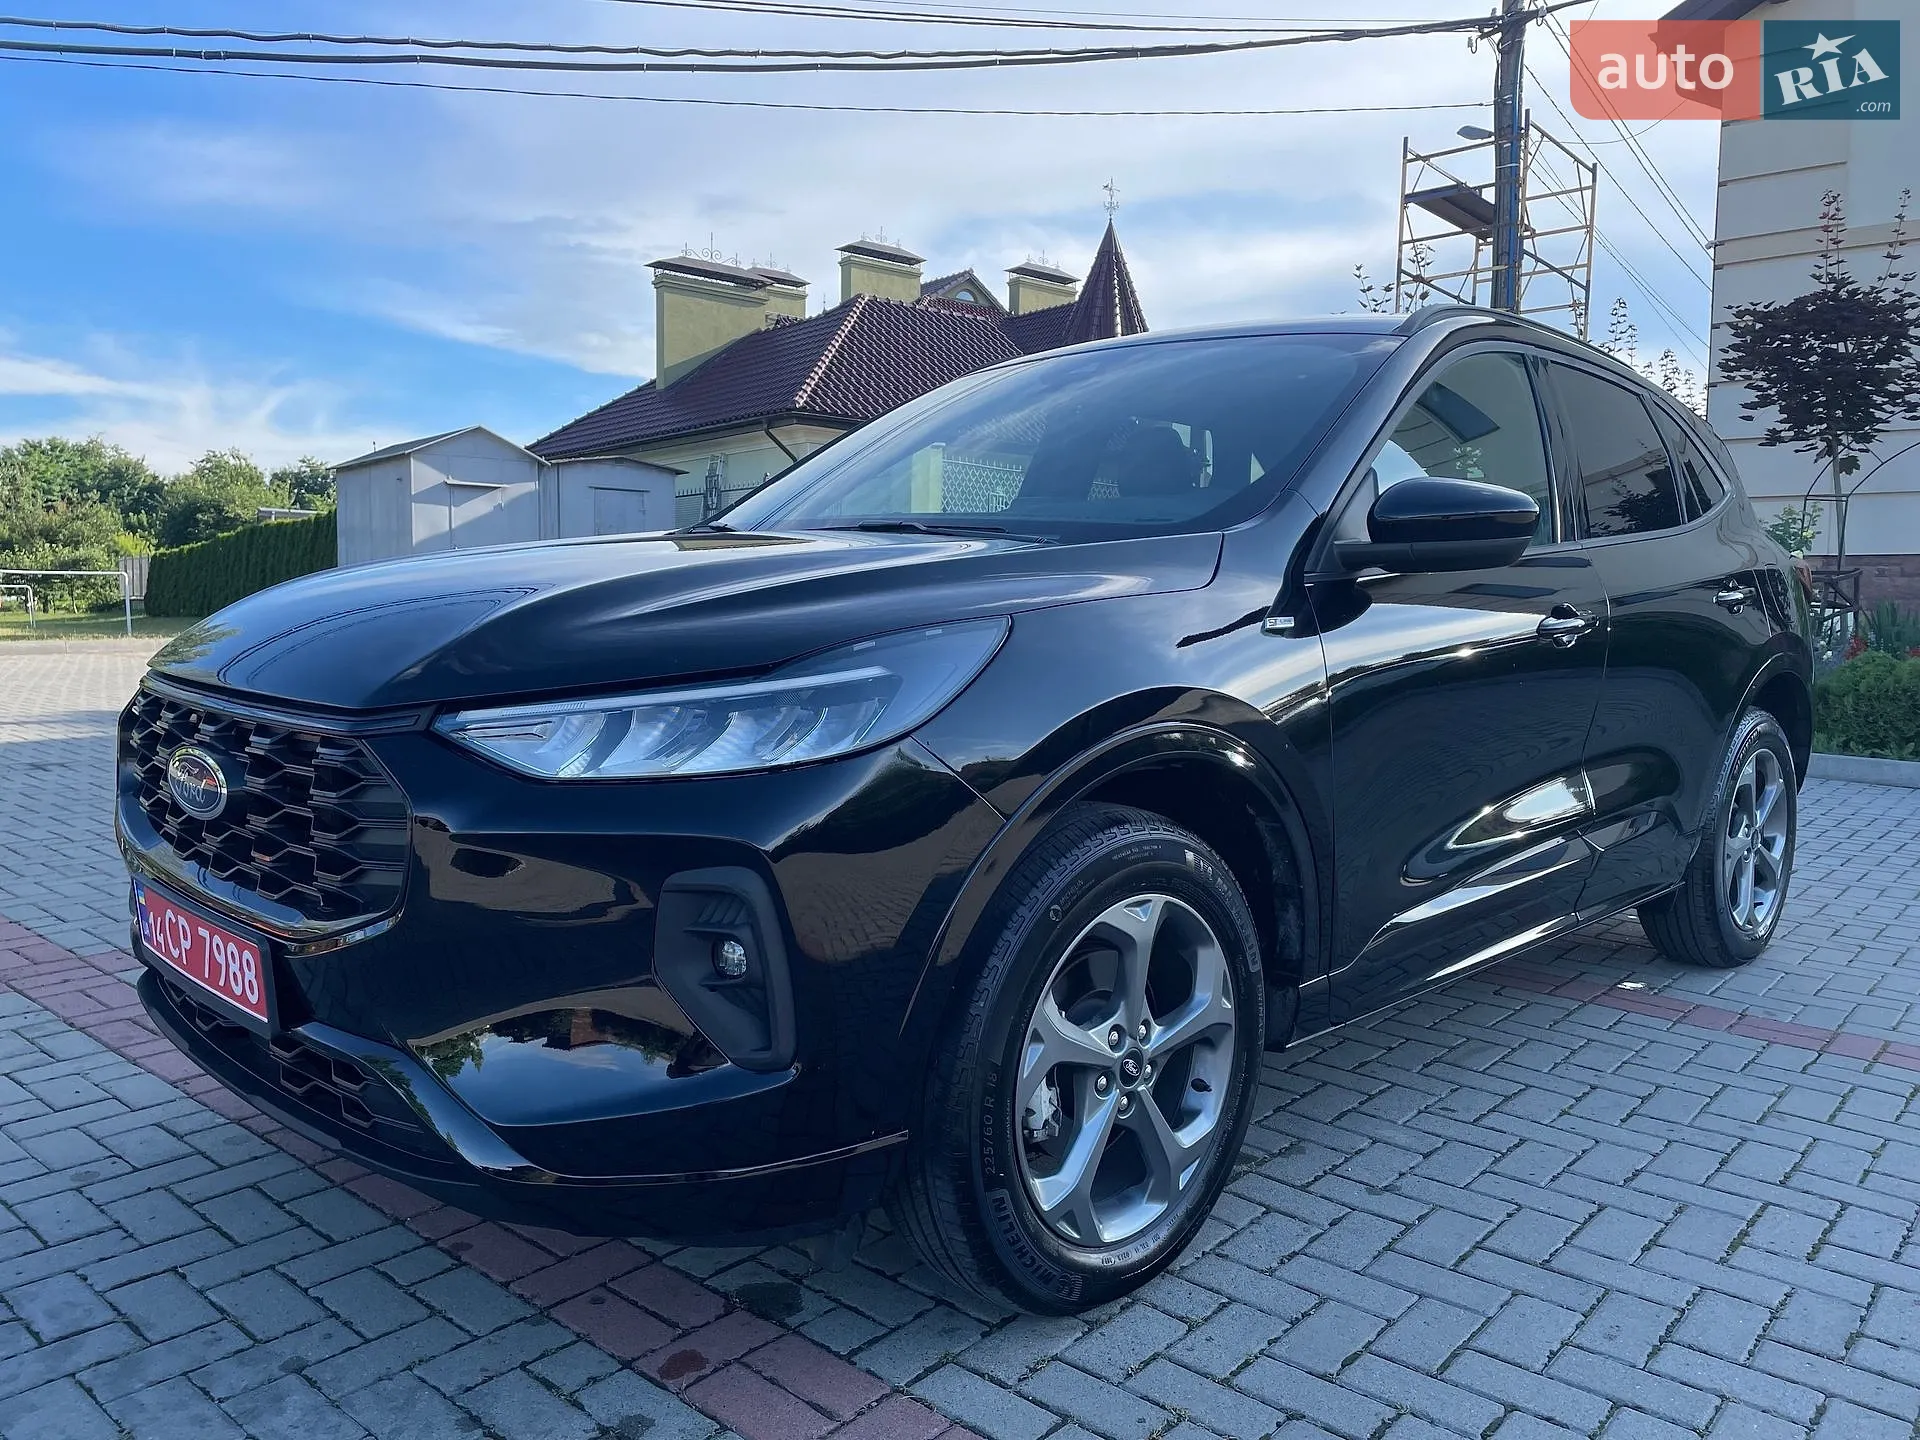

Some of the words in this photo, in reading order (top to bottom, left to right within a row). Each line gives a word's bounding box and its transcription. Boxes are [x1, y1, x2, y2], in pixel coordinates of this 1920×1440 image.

[173, 760, 207, 804] Ford
[198, 927, 260, 1005] 7988
[984, 1096, 995, 1108] R
[987, 1072, 998, 1088] 18
[984, 1115, 996, 1175] 225/60
[989, 1196, 1057, 1286] MICHELIN
